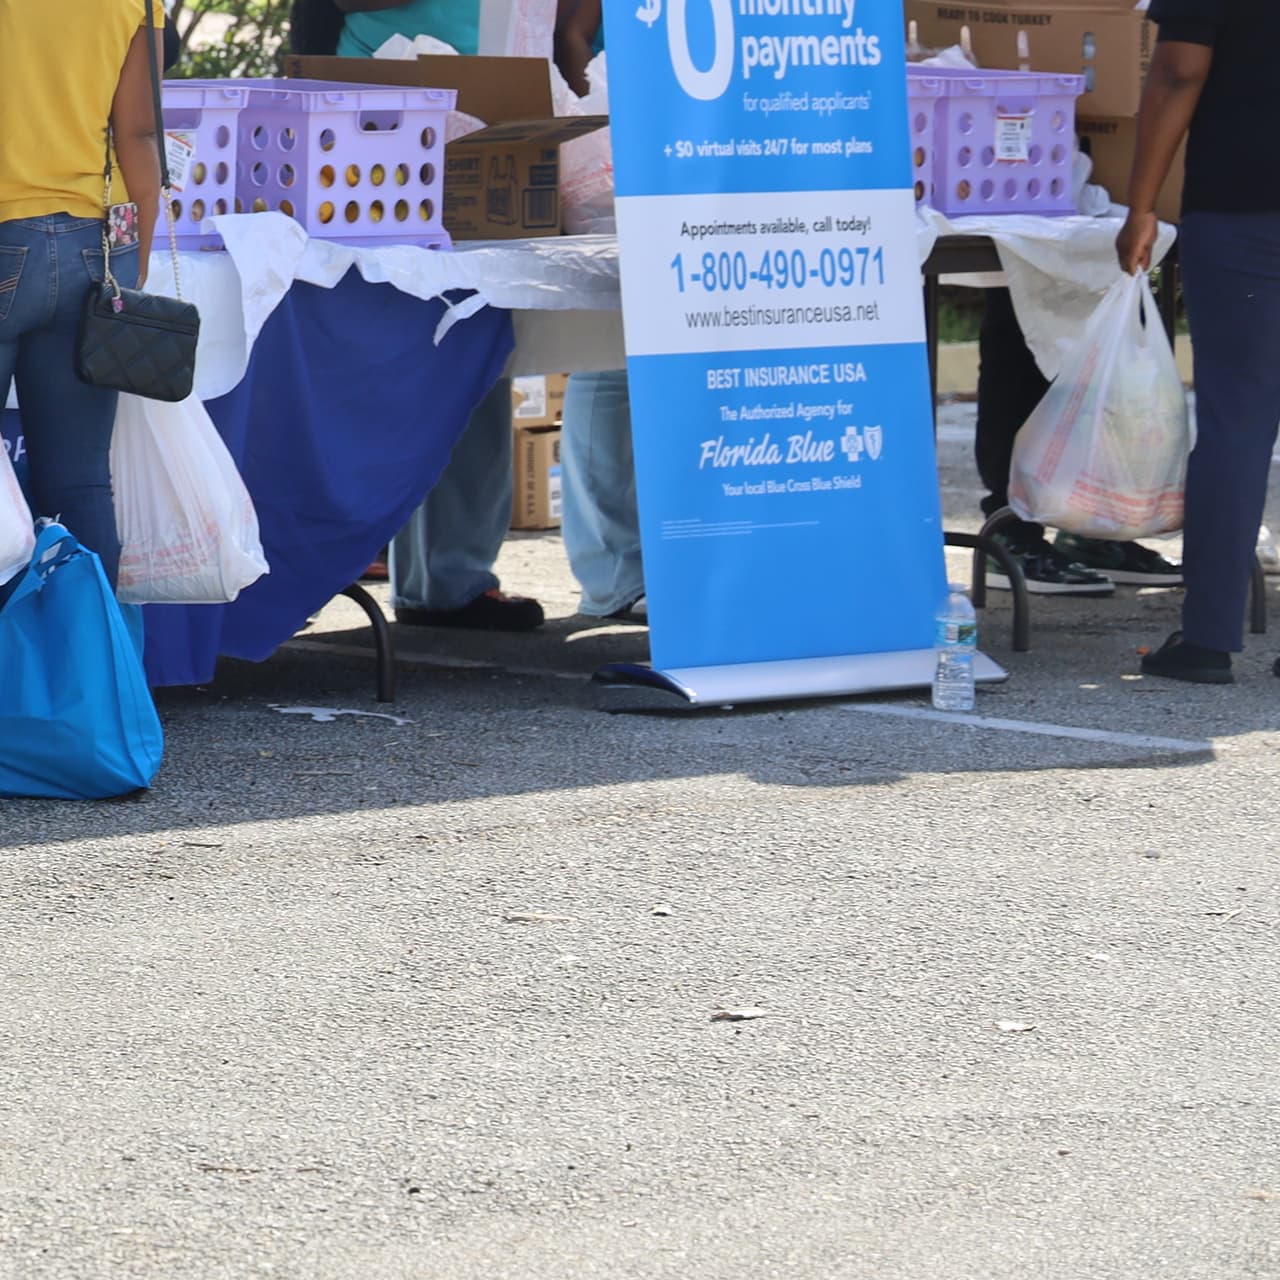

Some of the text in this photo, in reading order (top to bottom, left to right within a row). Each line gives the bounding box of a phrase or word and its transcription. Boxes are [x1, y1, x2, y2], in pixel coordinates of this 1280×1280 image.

[741, 28, 882, 80] payments
[743, 92, 758, 111] for
[759, 92, 809, 119] qualified
[675, 140, 693, 158] $0
[697, 139, 734, 157] virtual
[736, 139, 762, 156] visits
[763, 138, 788, 156] 24/7
[790, 137, 809, 155] for
[811, 138, 842, 155] most
[845, 136, 873, 158] plans
[680, 216, 872, 240] Appointments available, call today!
[670, 245, 885, 293] 1-800-490-0971
[685, 300, 880, 329] www.bestinsuranceusa.net
[706, 362, 867, 390] BEST INSURANCE USA
[720, 399, 854, 421] The Authorized Agency for
[698, 430, 835, 470] Florida Blue
[722, 483, 742, 496] Your
[744, 479, 766, 495] local
[767, 480, 786, 494] Blue
[812, 477, 832, 491] Blue
[833, 475, 861, 489] Shield
